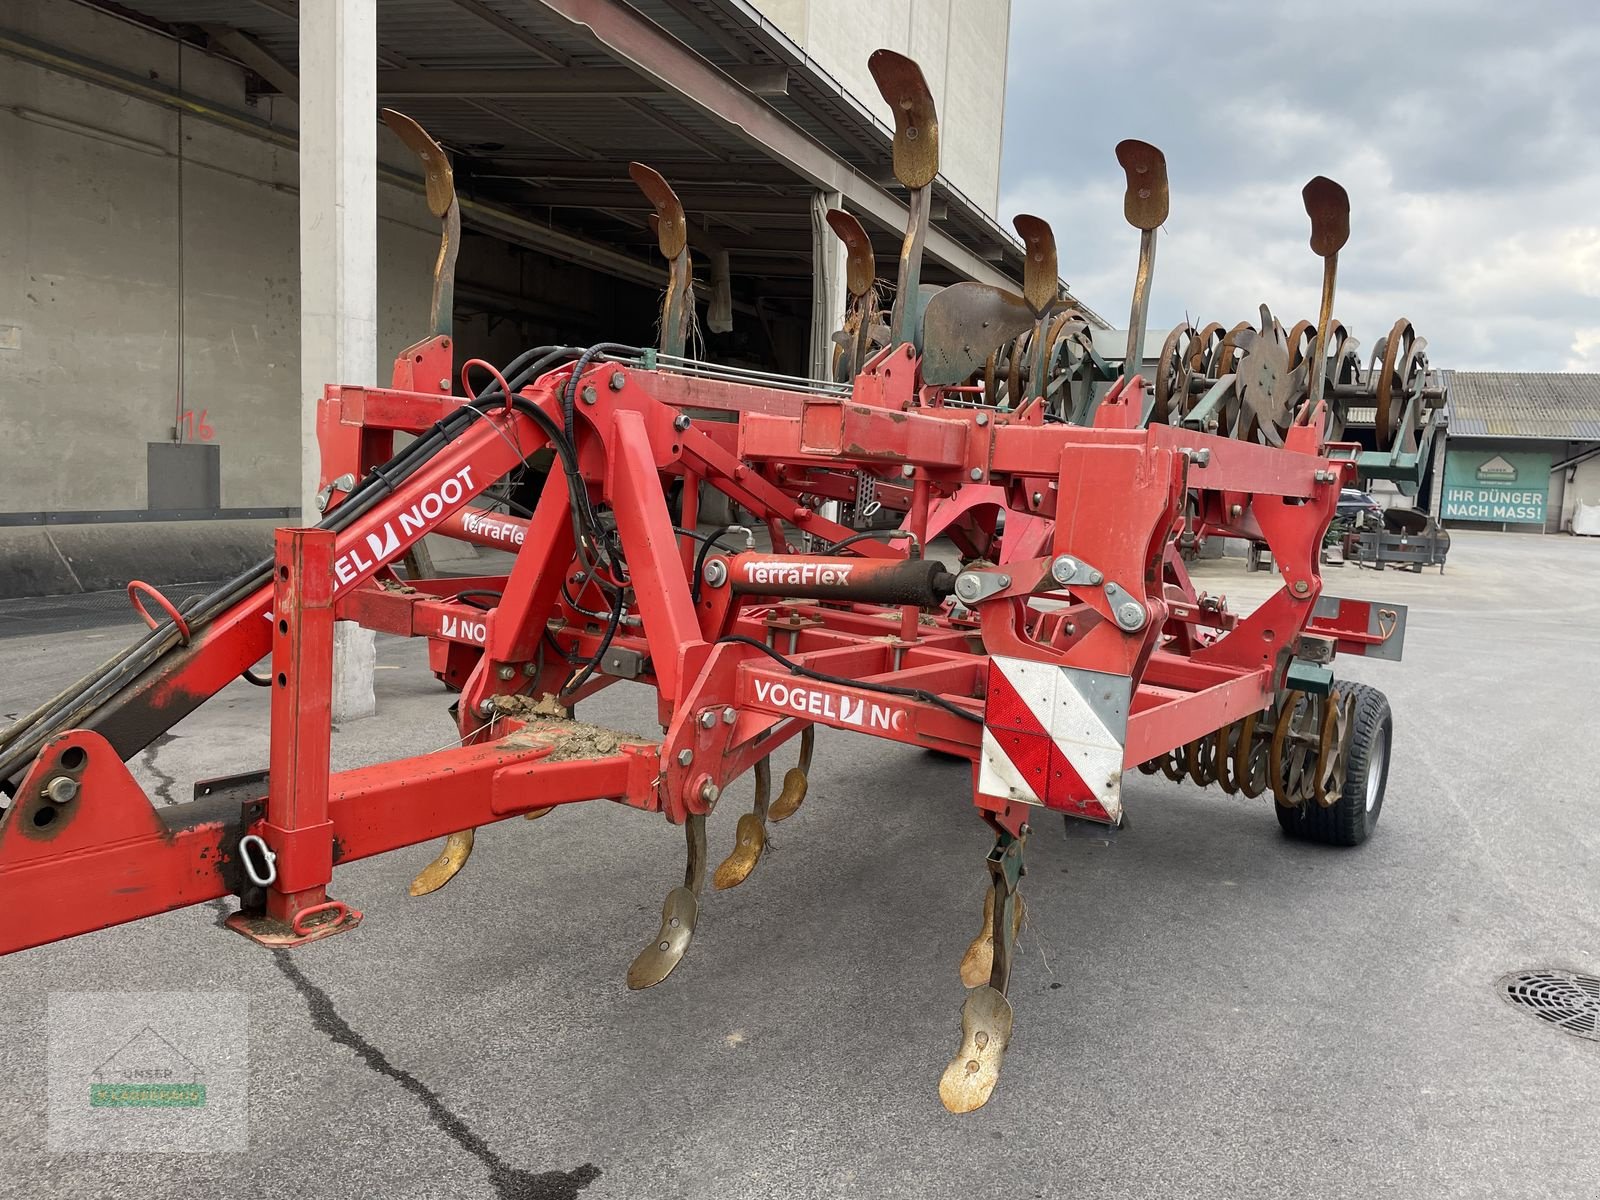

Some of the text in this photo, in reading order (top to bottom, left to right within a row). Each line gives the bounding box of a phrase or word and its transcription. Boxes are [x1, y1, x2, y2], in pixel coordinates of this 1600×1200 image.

[399, 465, 475, 536] NOOT
[1448, 488, 1542, 505] IHR DÜNGER
[1447, 504, 1541, 519] NACH MASS!
[461, 512, 524, 545] TerraFle
[744, 562, 853, 586] TerraFlex
[461, 620, 486, 642] NO
[754, 680, 836, 718] VOGEL
